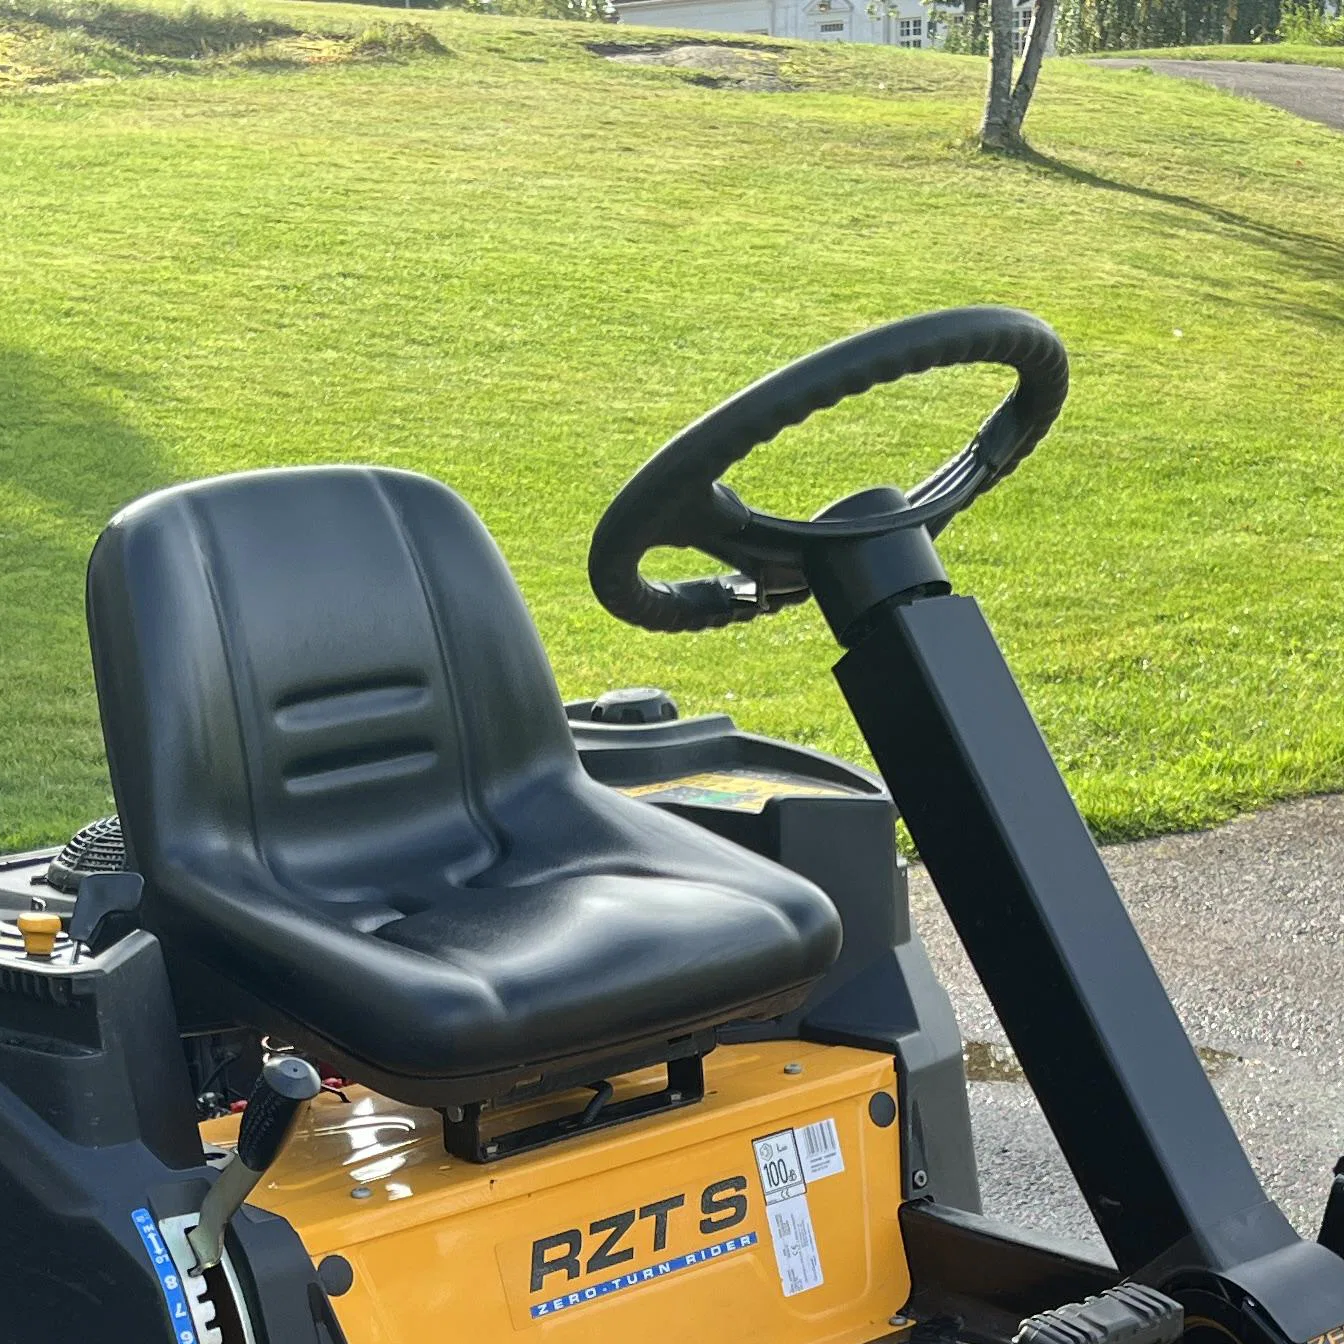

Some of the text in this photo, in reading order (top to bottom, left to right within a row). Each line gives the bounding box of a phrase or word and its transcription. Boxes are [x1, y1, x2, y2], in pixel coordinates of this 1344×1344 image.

[530, 1194, 685, 1293] RZT
[699, 1175, 748, 1235] S
[164, 1275, 179, 1290] 8
[537, 1263, 671, 1316] ZERO-TURN
[685, 1235, 751, 1265] RIDER
[175, 1303, 187, 1318] 7
